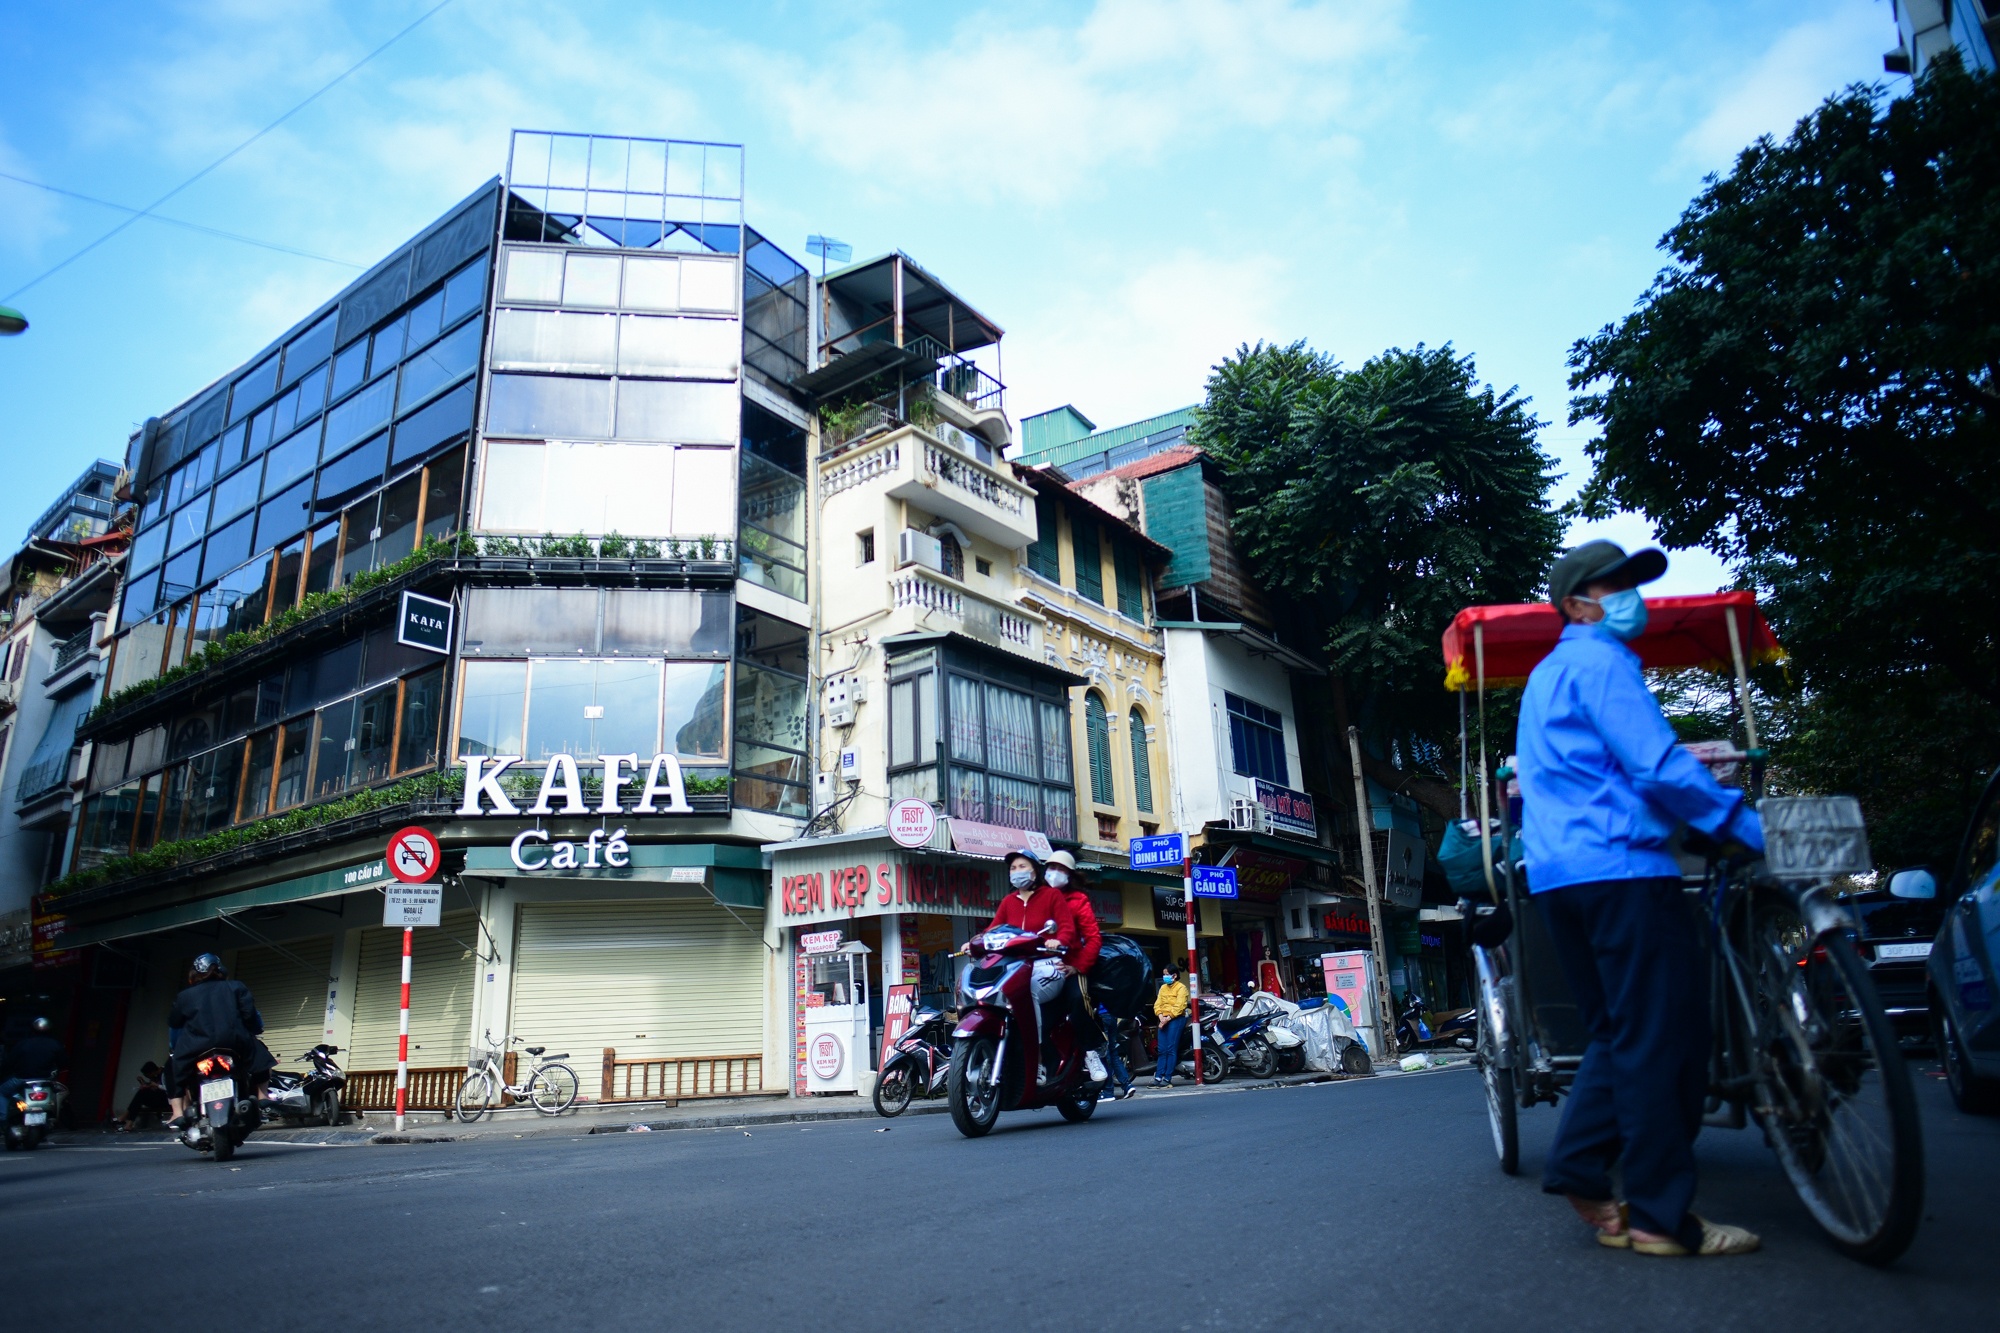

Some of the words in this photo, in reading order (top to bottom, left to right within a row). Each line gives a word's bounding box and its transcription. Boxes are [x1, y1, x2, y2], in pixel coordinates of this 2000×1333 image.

[410, 613, 442, 630] KAFA
[455, 752, 694, 815] KAFA
[901, 807, 924, 823] TASTY
[510, 828, 630, 871] Café
[964, 838, 982, 846] STUDIO
[1029, 835, 1049, 850] 98
[1152, 839, 1169, 847] PHỐ
[1135, 851, 1158, 864] ĐINH
[1160, 848, 1179, 862] LIỆT
[344, 871, 357, 883] 100
[1210, 869, 1224, 878] PHỐ
[781, 872, 824, 915] KEM
[830, 865, 871, 918] KẸP
[876, 862, 992, 909] SINGAPORE
[1165, 895, 1177, 906] SÚP
[1160, 910, 1182, 922] THANH
[803, 936, 821, 945] KEM
[818, 1041, 833, 1057] TASTY
